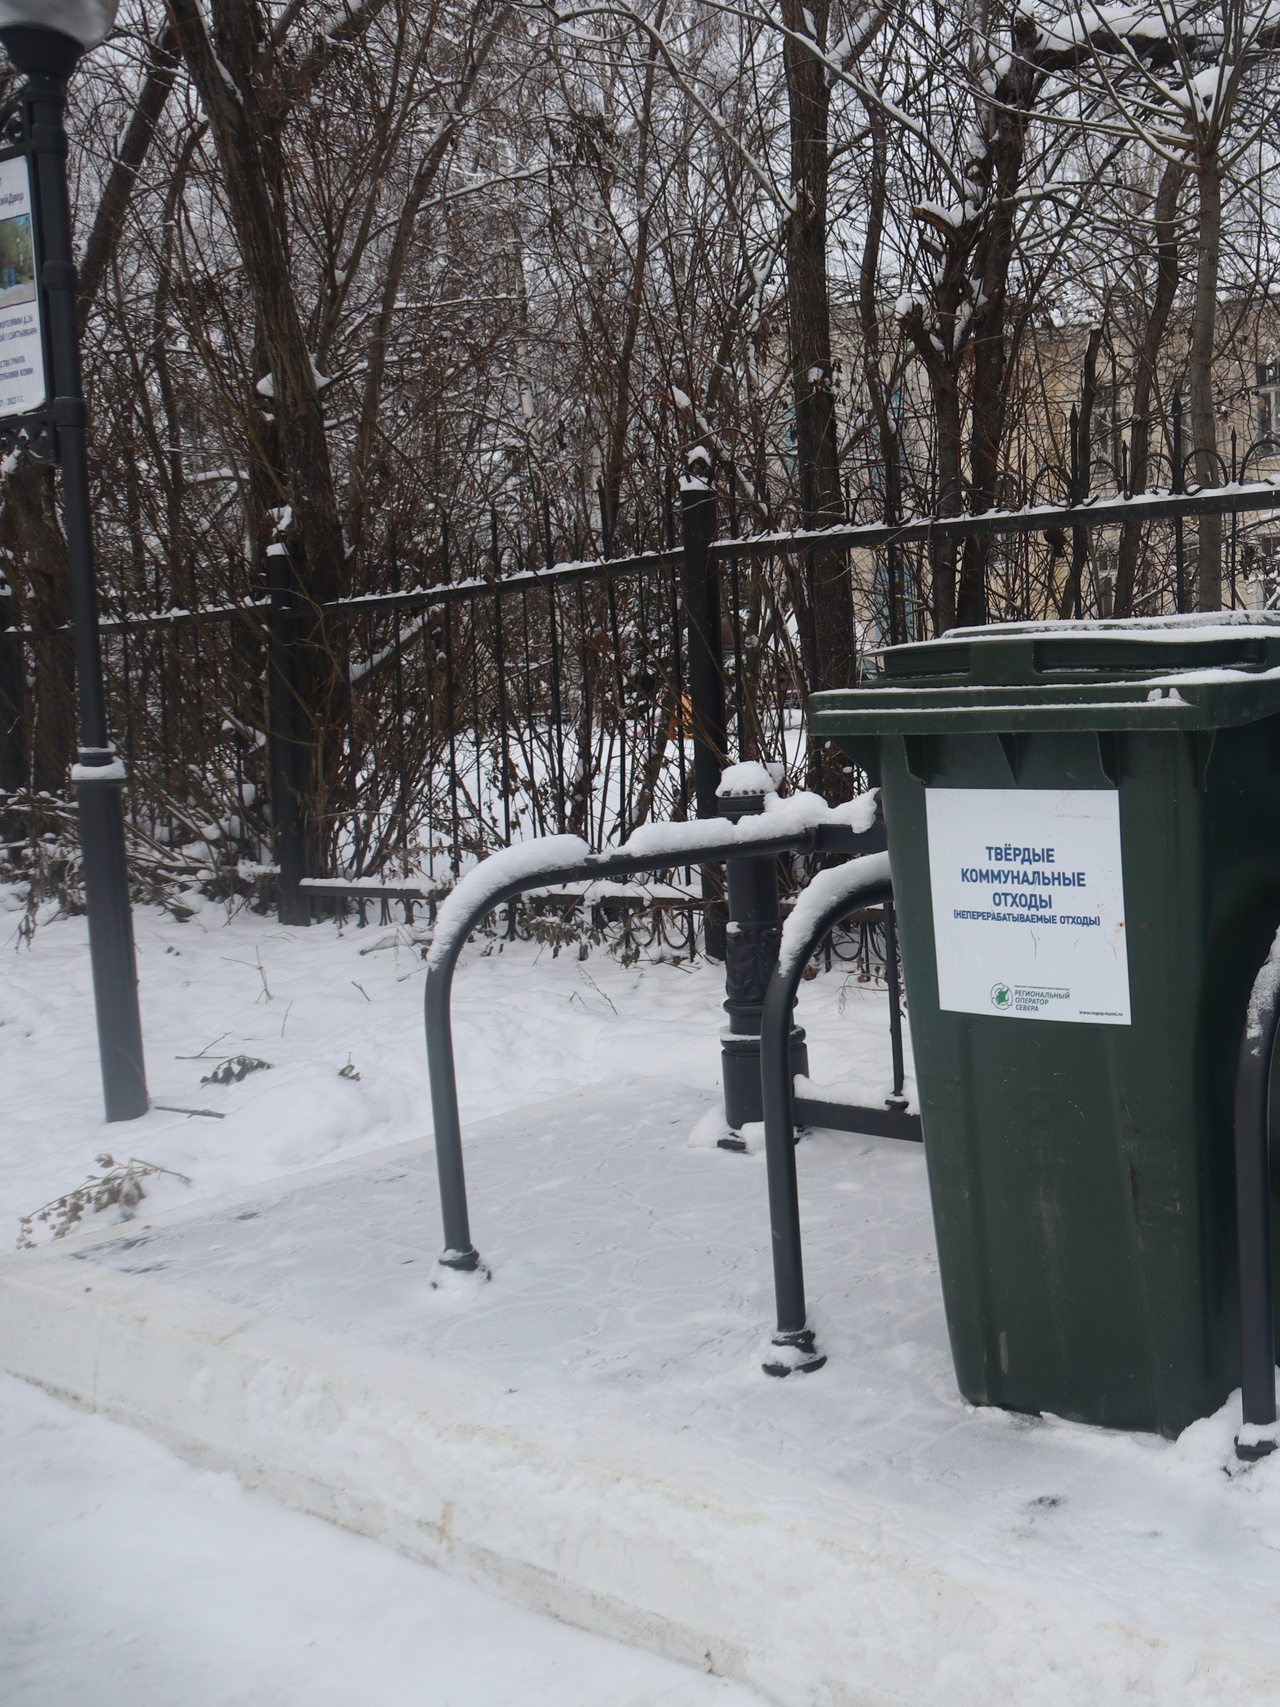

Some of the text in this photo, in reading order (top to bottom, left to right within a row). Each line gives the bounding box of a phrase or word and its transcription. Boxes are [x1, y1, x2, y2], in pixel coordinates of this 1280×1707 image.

[986, 844, 1055, 865] ТВЁРДЫЕ
[961, 868, 1086, 887] КОММУНАЛЬНЫЕ
[993, 892, 1052, 911] ОТХОДЫ
[954, 910, 1100, 927] (НЕПЕРЕРАБАТЫВАЕМЫЕ ОТХОДЫ)
[1014, 989, 1070, 999] РЕГИОНАЛЬНЫЙ
[1015, 997, 1049, 1005] ОПЕРАТОР
[1016, 1004, 1039, 1012] СЕВЕРА
